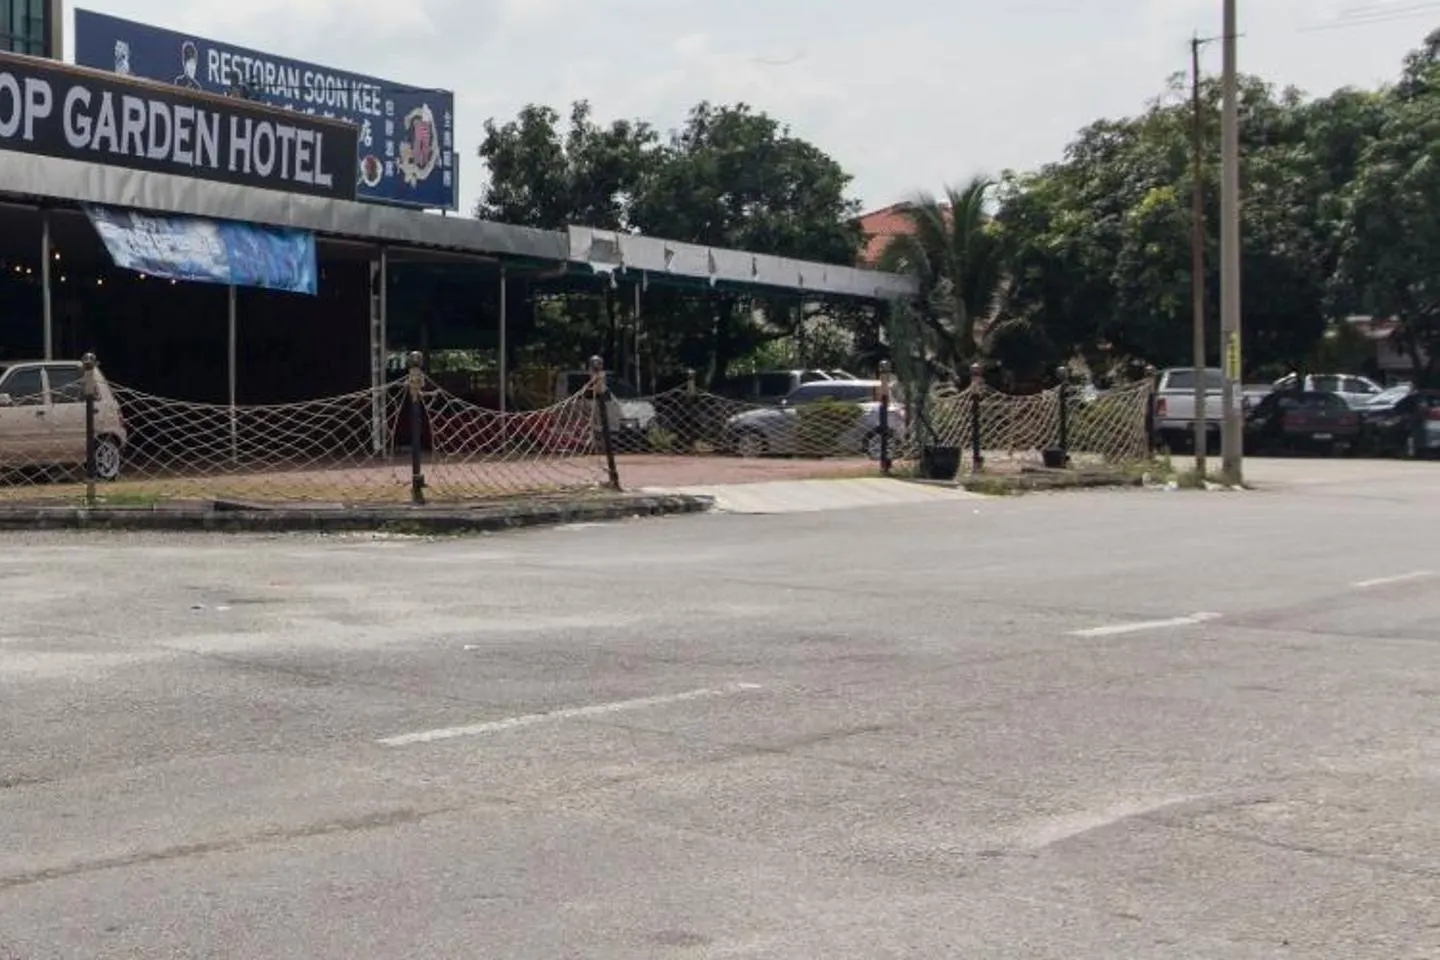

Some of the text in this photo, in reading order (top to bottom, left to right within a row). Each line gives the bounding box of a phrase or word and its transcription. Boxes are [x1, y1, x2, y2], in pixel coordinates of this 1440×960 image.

[206, 48, 301, 101] RESTORAN
[303, 70, 350, 109] SOON
[351, 81, 383, 116] KEE
[62, 85, 220, 169] GARDEN
[227, 113, 334, 188] HOTEL
